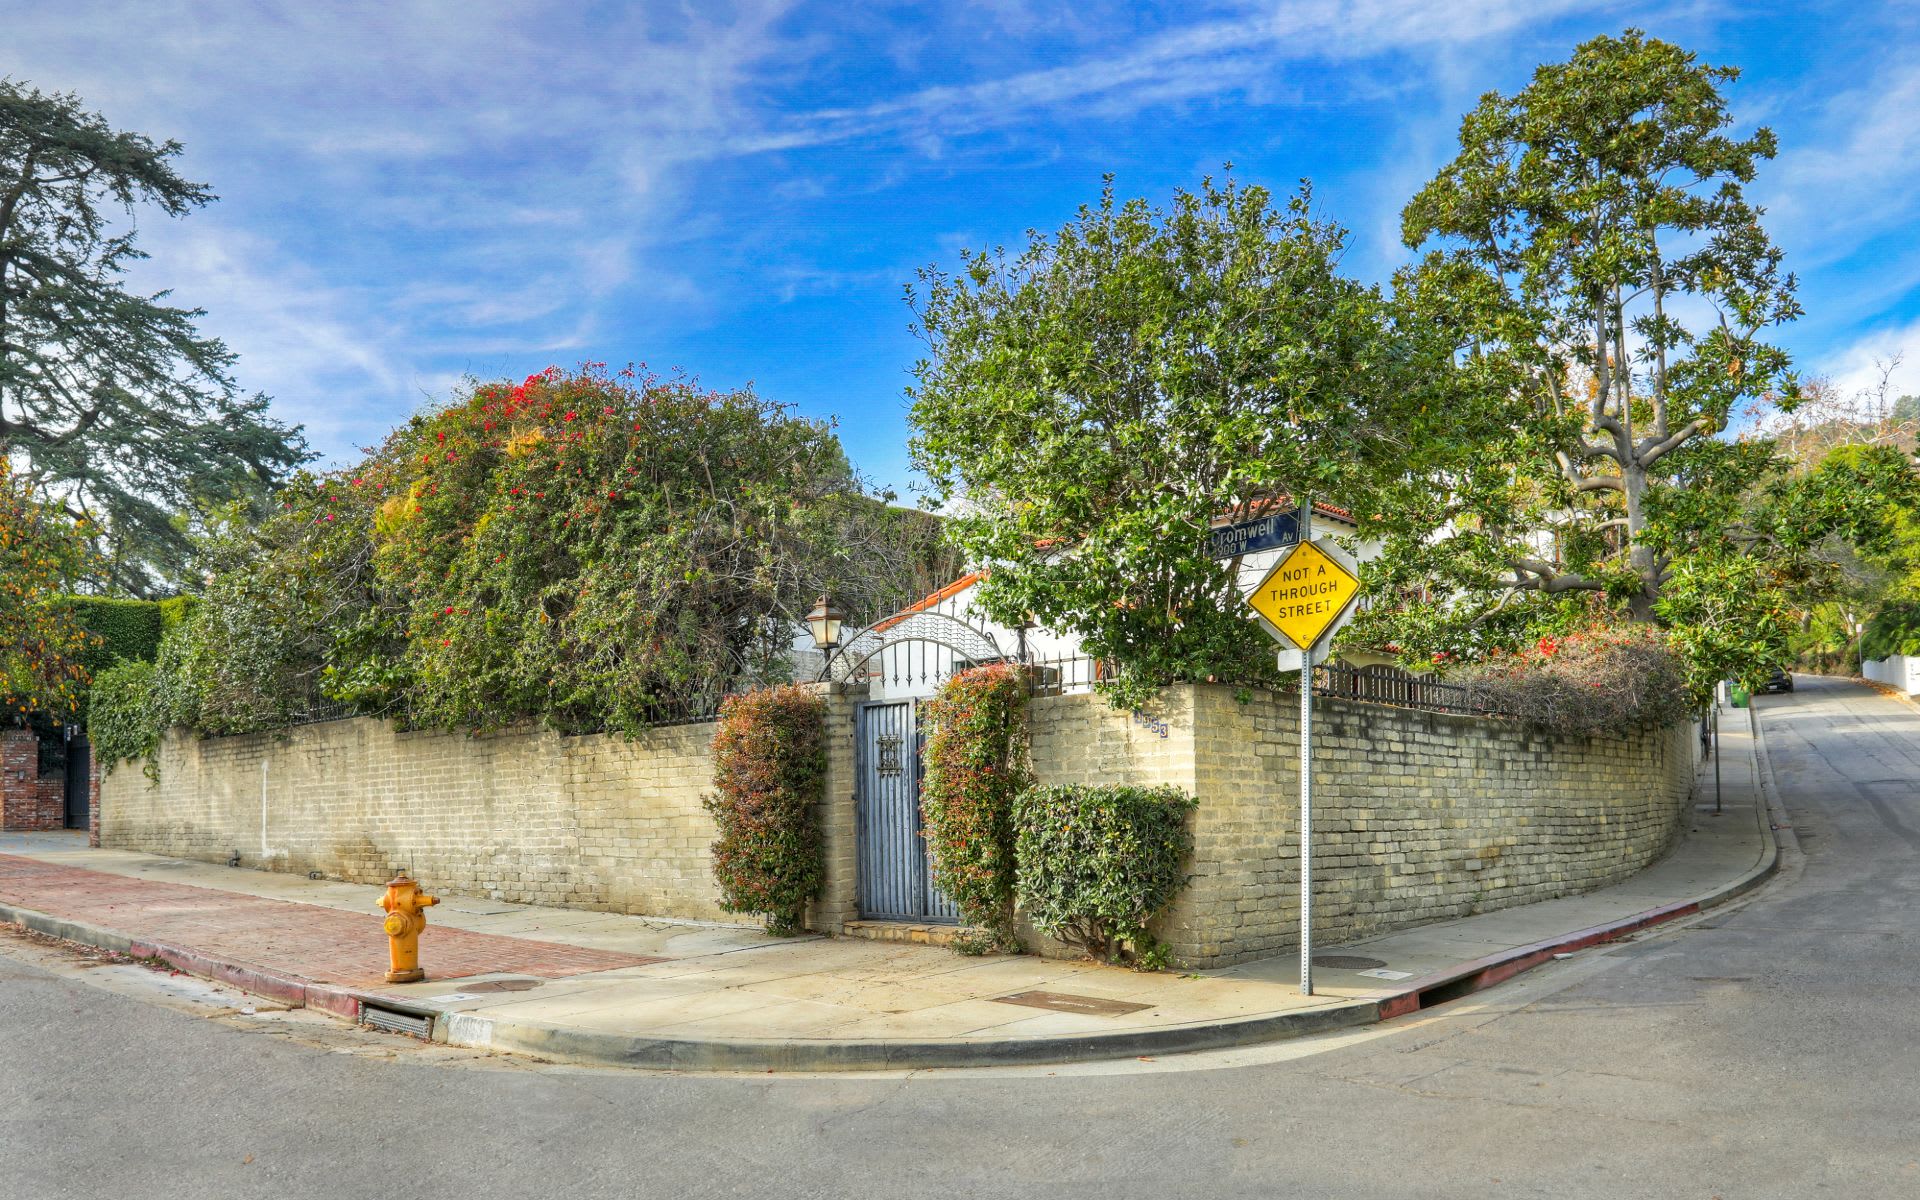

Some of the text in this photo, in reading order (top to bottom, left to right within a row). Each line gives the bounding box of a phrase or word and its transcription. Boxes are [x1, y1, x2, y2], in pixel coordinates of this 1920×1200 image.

[1212, 517, 1274, 546] Cromwell
[1282, 531, 1293, 543] Av
[1214, 540, 1248, 557] 900 W
[1283, 564, 1326, 582] NOT A
[1271, 580, 1338, 602] THROUGH
[1279, 599, 1332, 619] STREET
